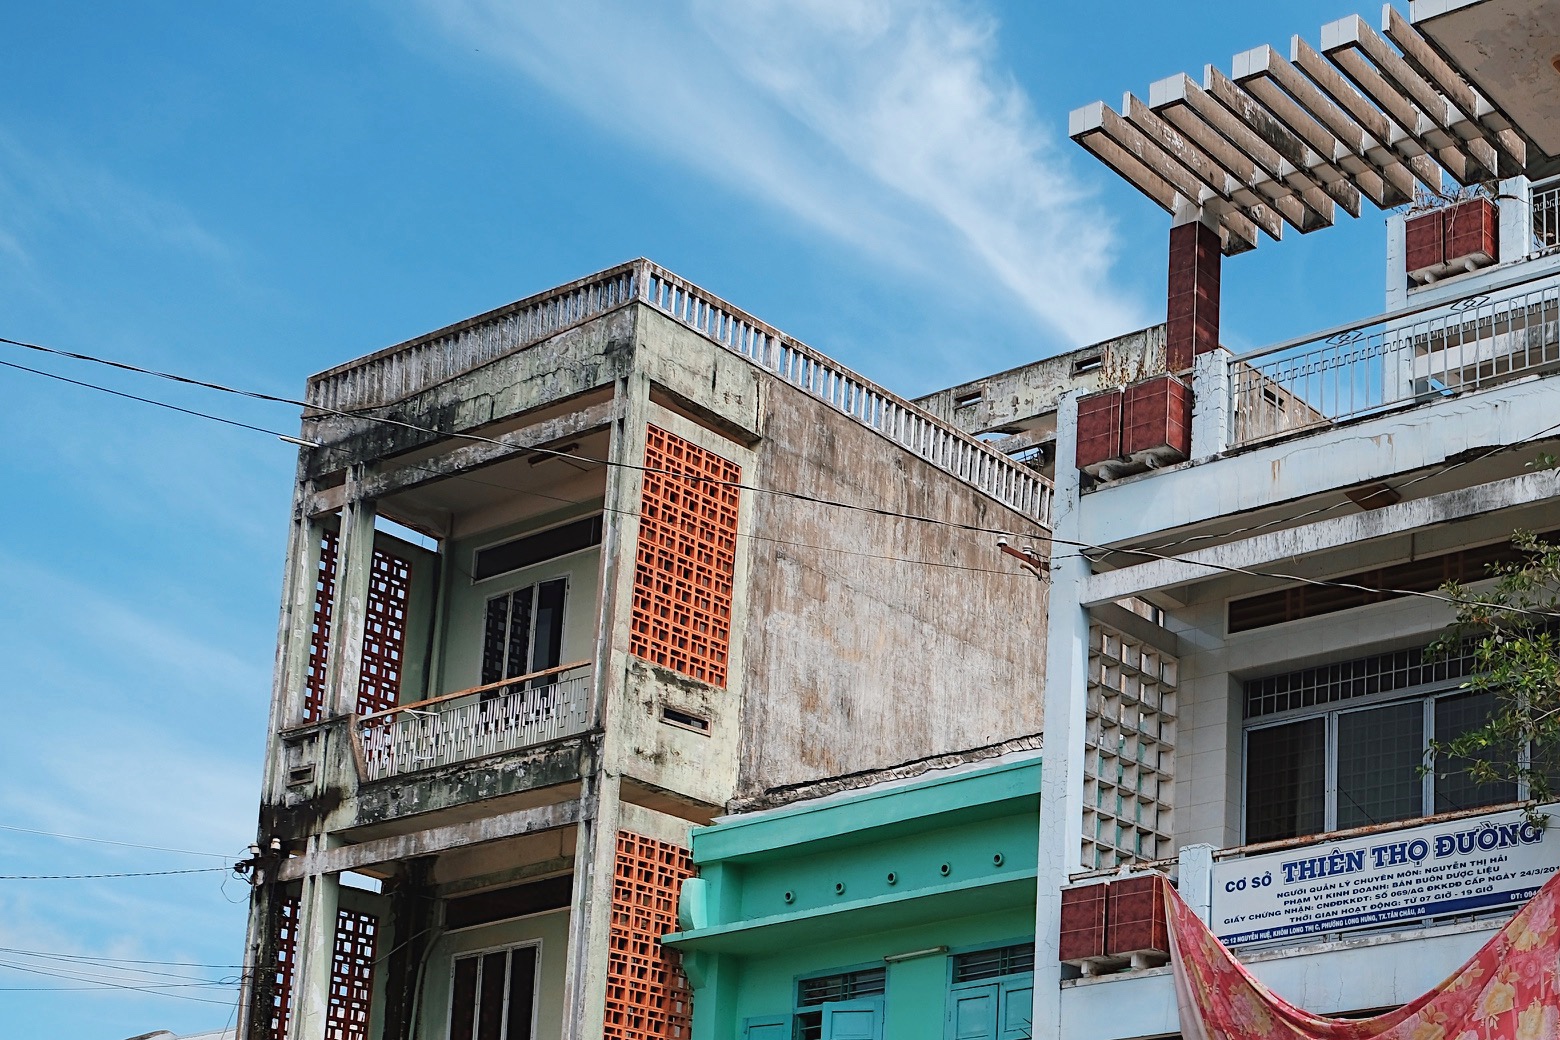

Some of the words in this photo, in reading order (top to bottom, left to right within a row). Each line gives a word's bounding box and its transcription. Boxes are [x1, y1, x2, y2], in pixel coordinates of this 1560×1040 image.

[1225, 877, 1247, 893] CƠ
[1251, 871, 1273, 889] SỞ
[1281, 847, 1367, 885] THIÊN
[1370, 838, 1430, 870] THỌ
[1434, 820, 1544, 859] ĐƯỜNG
[1276, 888, 1307, 899] NGƯỜI
[1309, 881, 1336, 893] QUẢN
[1339, 878, 1351, 889] LÝ
[1353, 873, 1394, 886] CHUYÊN
[1397, 869, 1422, 878] MÔN:
[1424, 861, 1467, 874] NGUYỄN
[1470, 857, 1488, 867] THỊ
[1490, 854, 1508, 863] HẢI
[1223, 913, 1246, 925] GIẤY
[1248, 908, 1282, 921] CHỨNG
[1284, 904, 1314, 915] NHẬN:
[1374, 892, 1388, 900] SỐ
[1464, 875, 1486, 886] CẤP
[1488, 871, 1517, 883] NGÀY
[1283, 896, 1311, 906] PHẠM
[1313, 893, 1323, 901] VI
[1325, 888, 1350, 899] KINH
[1352, 884, 1389, 895] DOANH:
[1392, 879, 1413, 888] BÁN
[1415, 873, 1444, 884] BUÔN
[1446, 869, 1475, 881] DƯỢC
[1476, 866, 1500, 876] LIỆU
[1289, 914, 1312, 923] THỜI
[1314, 910, 1338, 919] GIAN
[1341, 905, 1368, 915] HOẠT
[1370, 900, 1401, 910] ĐỘNG:
[1404, 896, 1418, 905] TỪ
[1420, 895, 1431, 903] 07
[1433, 890, 1452, 900] GIỜ
[1461, 889, 1473, 897] 19
[1344, 917, 1359, 926] LONG
